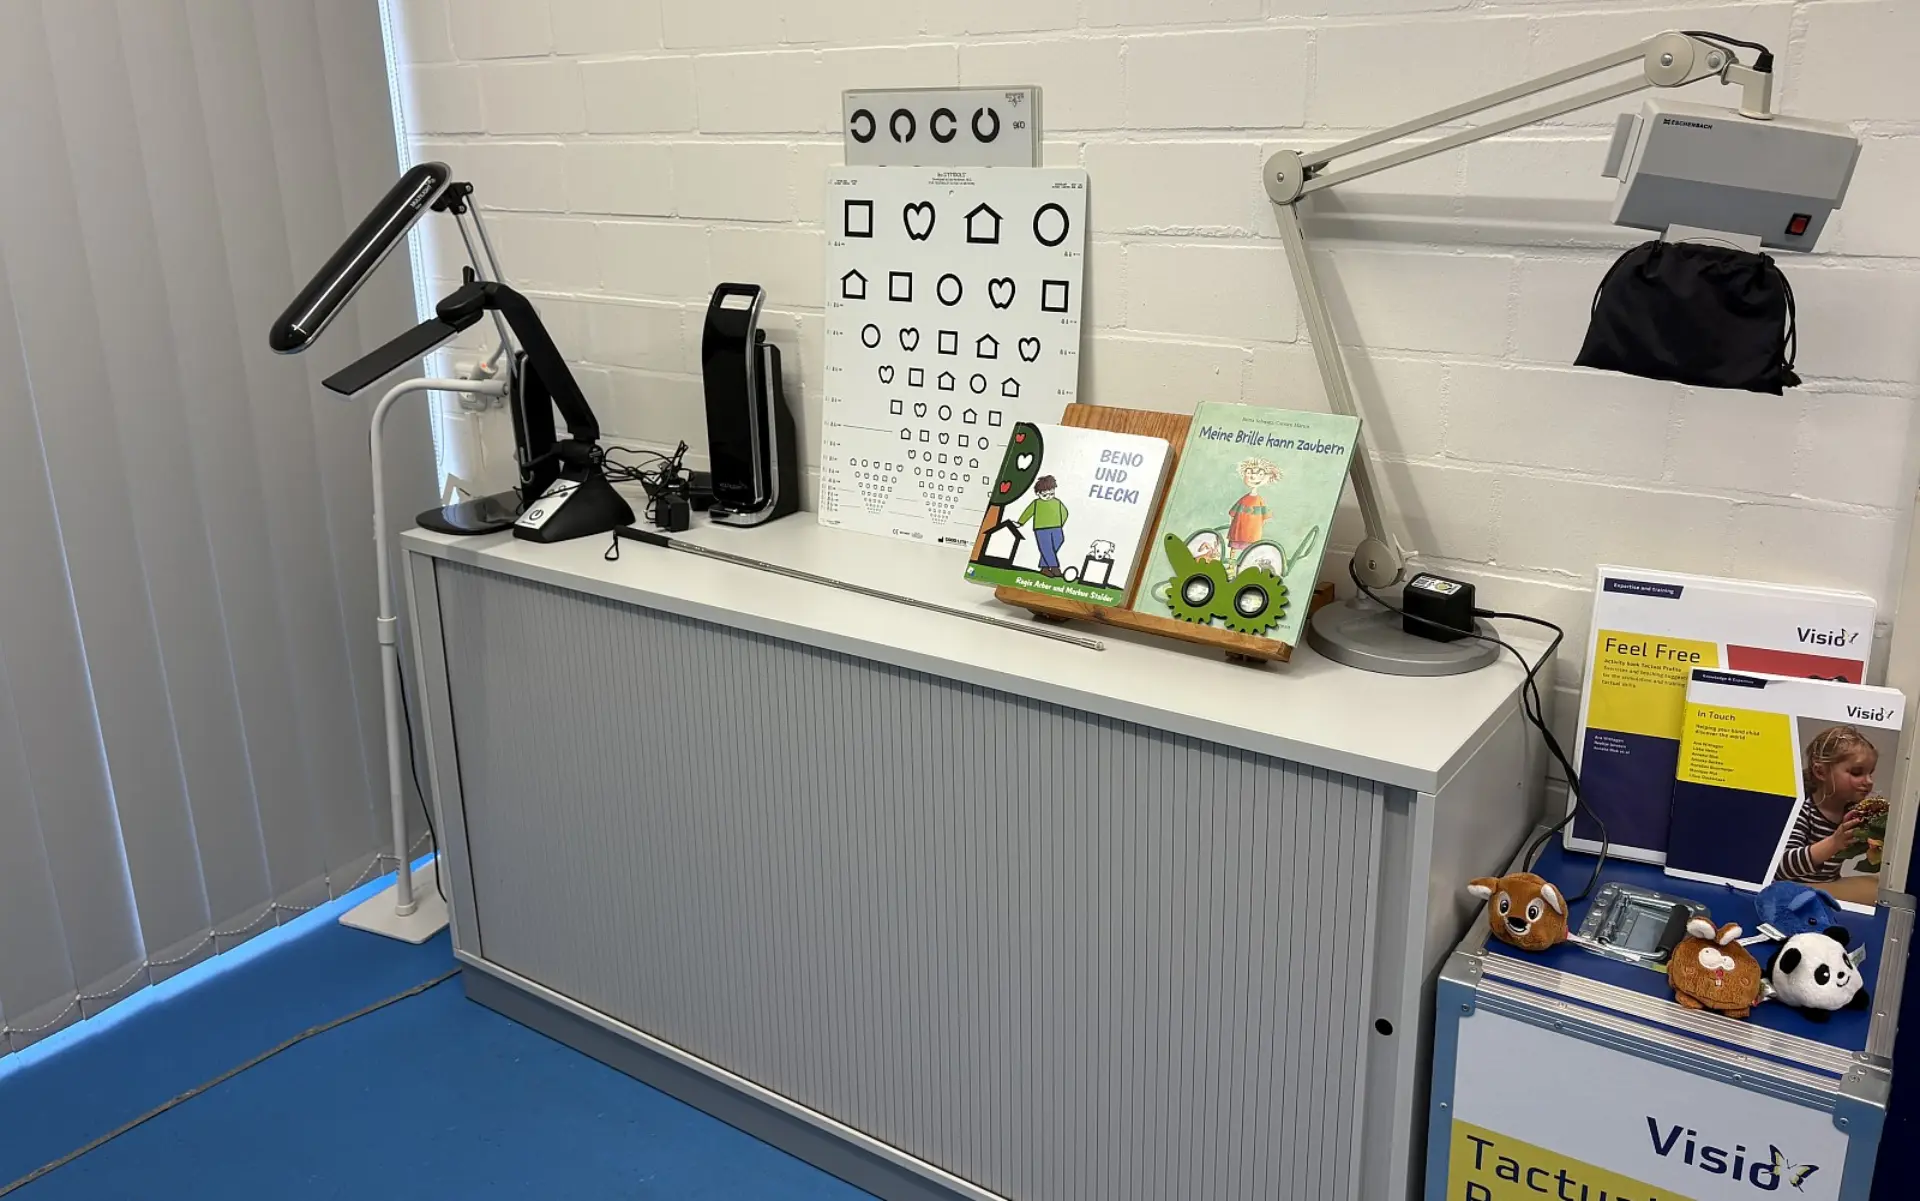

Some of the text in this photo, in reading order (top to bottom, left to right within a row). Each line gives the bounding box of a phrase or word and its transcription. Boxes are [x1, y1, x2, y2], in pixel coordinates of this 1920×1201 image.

[1199, 426, 1234, 442] Meine
[1235, 429, 1265, 446] Brille
[1265, 433, 1295, 450] kann
[1100, 449, 1144, 468] BENO
[1095, 467, 1128, 483] UND
[1088, 484, 1140, 505] FLECKI
[1613, 582, 1640, 591] Expertise
[1652, 587, 1674, 595] training
[1797, 626, 1846, 647] Visio
[1605, 637, 1701, 663] Feel Free
[1702, 674, 1728, 682] Knowledge
[1697, 710, 1736, 721] In Touch
[1847, 705, 1885, 722] Visio
[1646, 1115, 1781, 1192] Visio
[1466, 1134, 1656, 1201] Tactu
